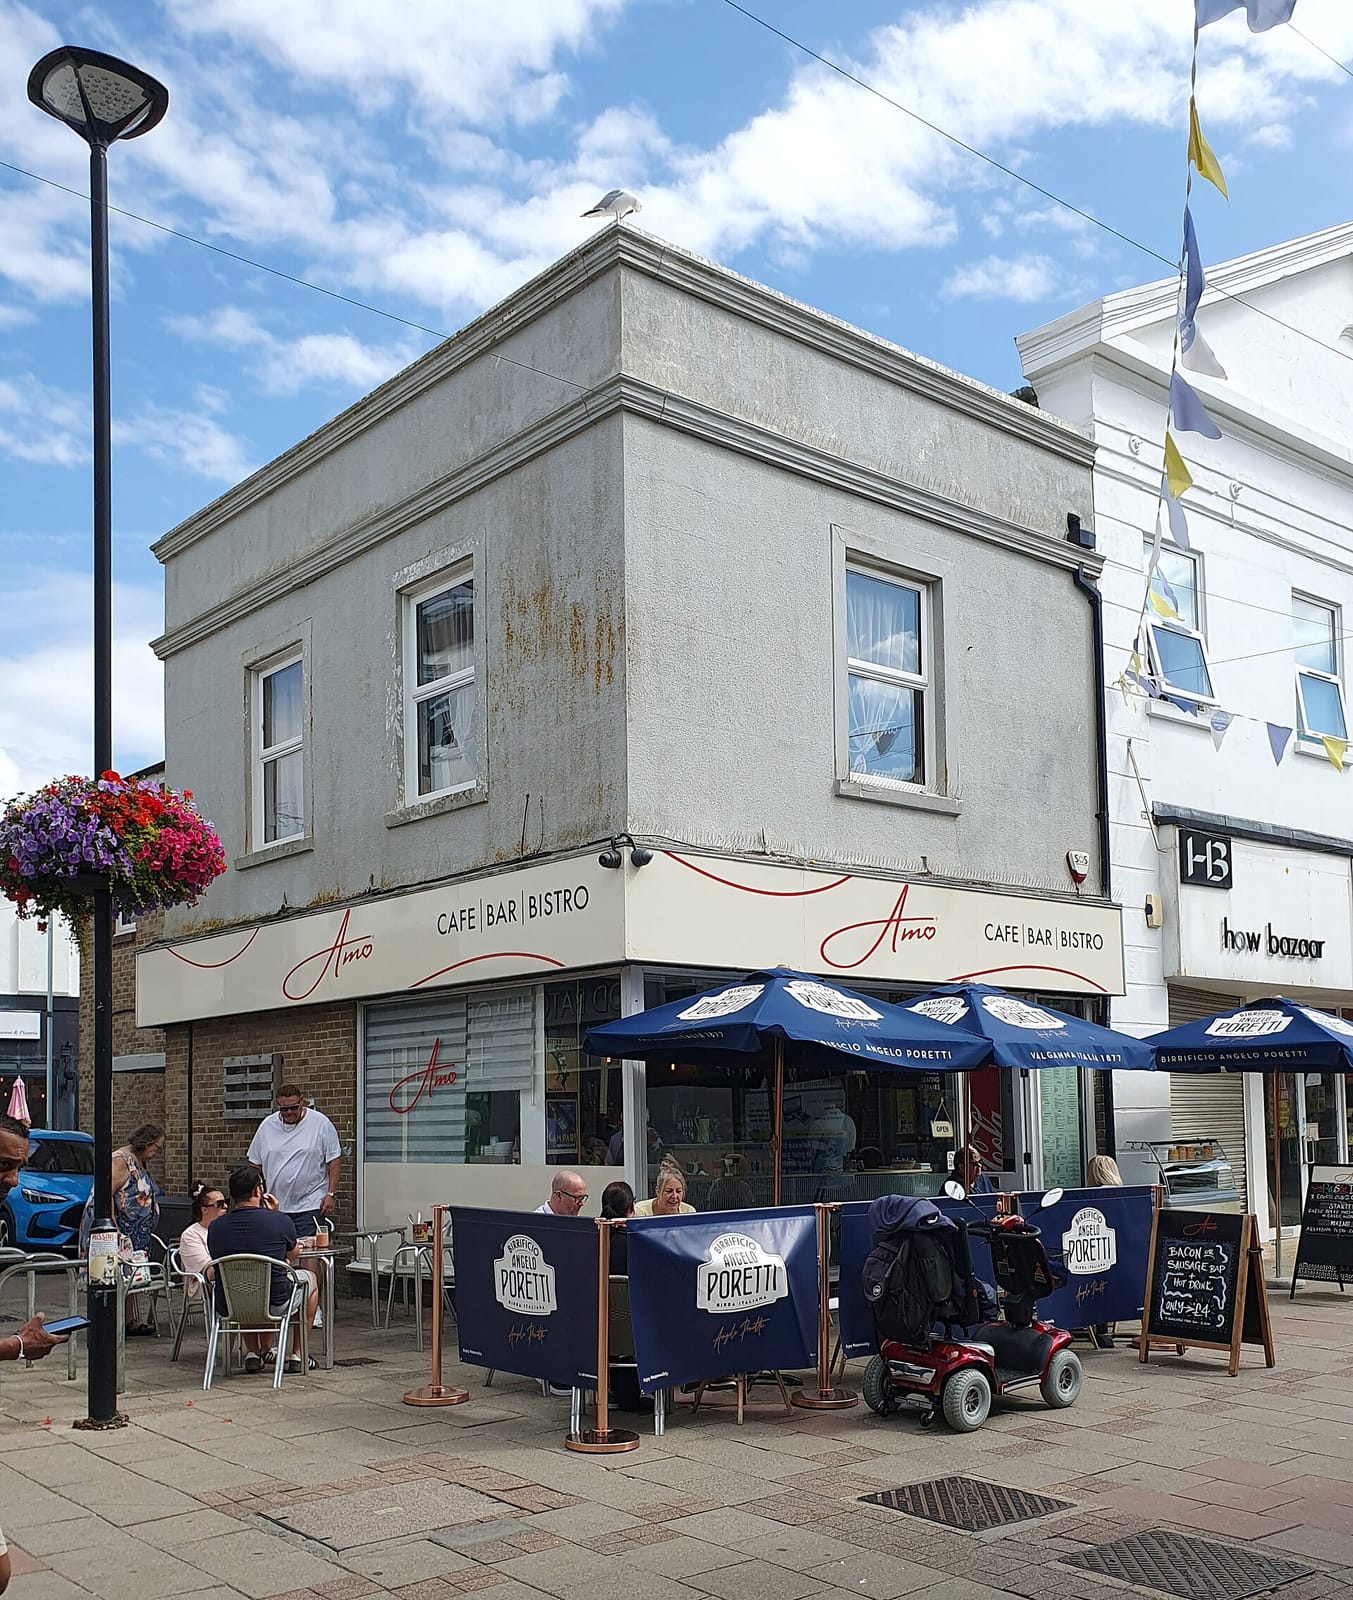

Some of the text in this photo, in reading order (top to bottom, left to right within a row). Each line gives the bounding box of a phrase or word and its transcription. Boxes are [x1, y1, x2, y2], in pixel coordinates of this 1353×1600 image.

[1074, 854, 1088, 865] SOS
[1187, 836, 1229, 882] HB
[1223, 916, 1326, 959] how bazaar
[1215, 1020, 1282, 1033] PORETTI
[866, 1044, 903, 1058] ANGELO
[906, 1049, 952, 1060] PORETTI
[1100, 1053, 1121, 1062] 1877
[1160, 1050, 1308, 1063] BIRRIFICIO ANGELO PORETTI
[936, 1125, 949, 1133] OPEN
[1075, 1211, 1103, 1225] BIRRIFICIO
[1078, 1224, 1100, 1237] ANGELO
[507, 1239, 539, 1257] BIRRIFICIO
[713, 1237, 756, 1255] BIRRIFICIO
[1068, 1237, 1111, 1264] PORETTI
[1168, 1246, 1202, 1259] BACON
[511, 1254, 537, 1270] ANGELO
[723, 1251, 758, 1268] ANGELO
[1167, 1260, 1226, 1273] SAUSAGE BAP
[500, 1269, 550, 1303] PORETTI
[707, 1264, 777, 1301] PORETTI
[1173, 1278, 1214, 1291] HOT DRINK
